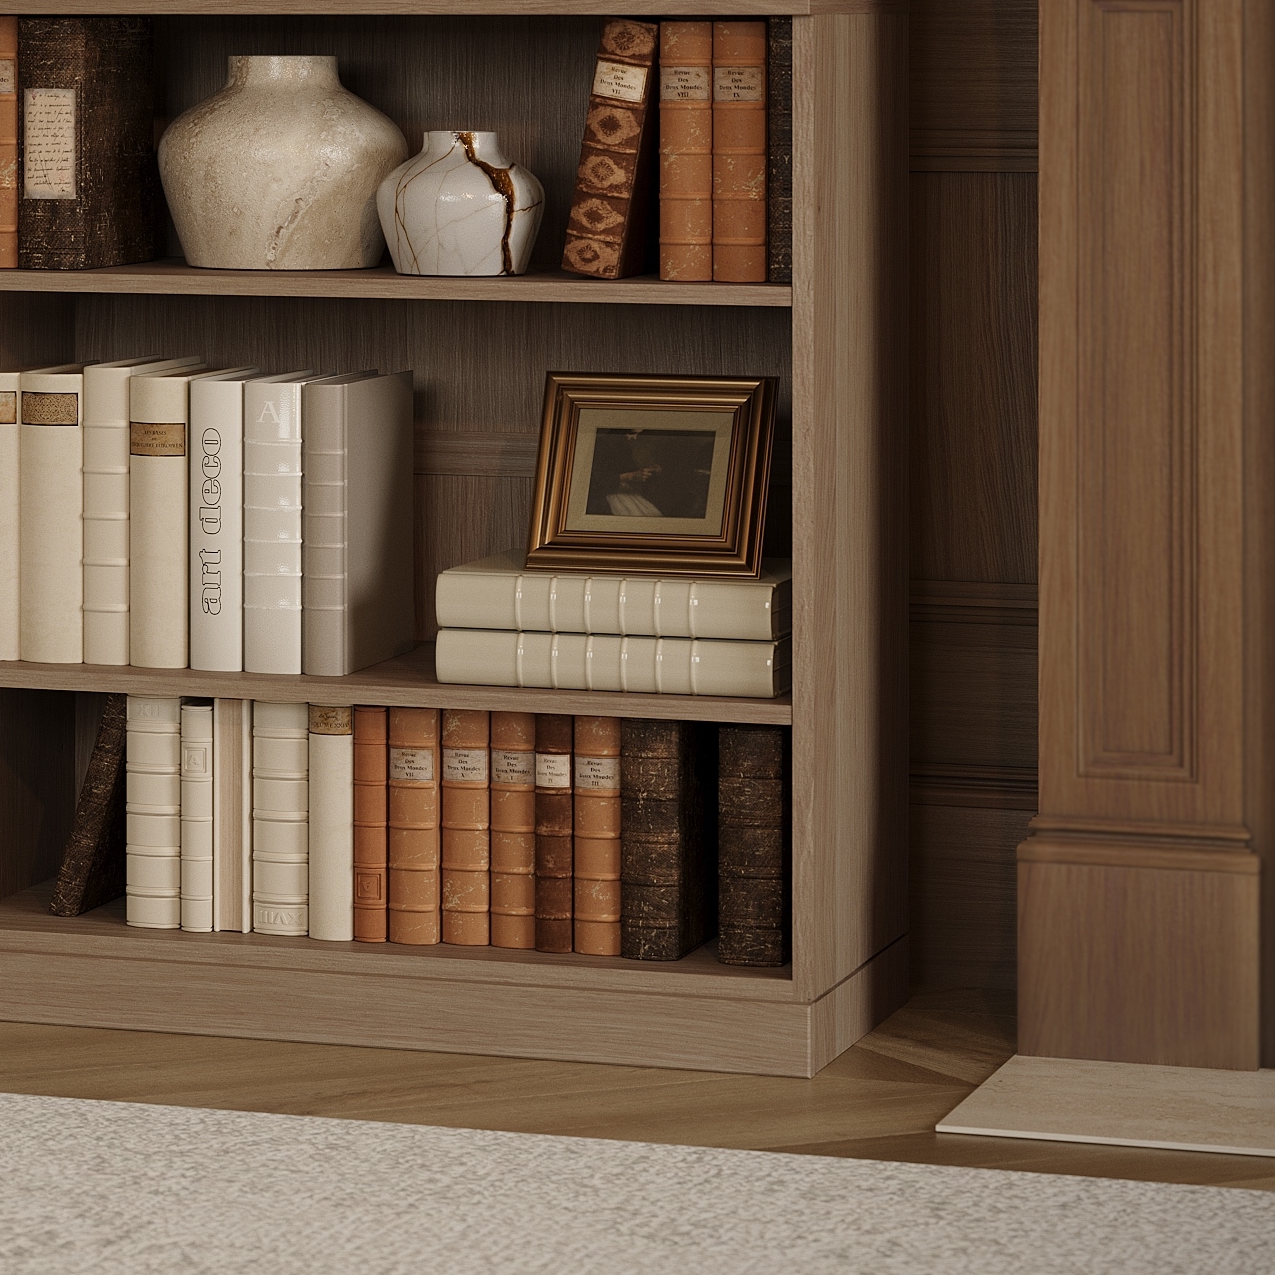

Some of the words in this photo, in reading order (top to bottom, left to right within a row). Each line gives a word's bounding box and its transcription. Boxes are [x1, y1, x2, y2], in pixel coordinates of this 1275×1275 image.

[257, 401, 280, 423] A
[198, 428, 222, 534] deco
[198, 548, 222, 615] art
